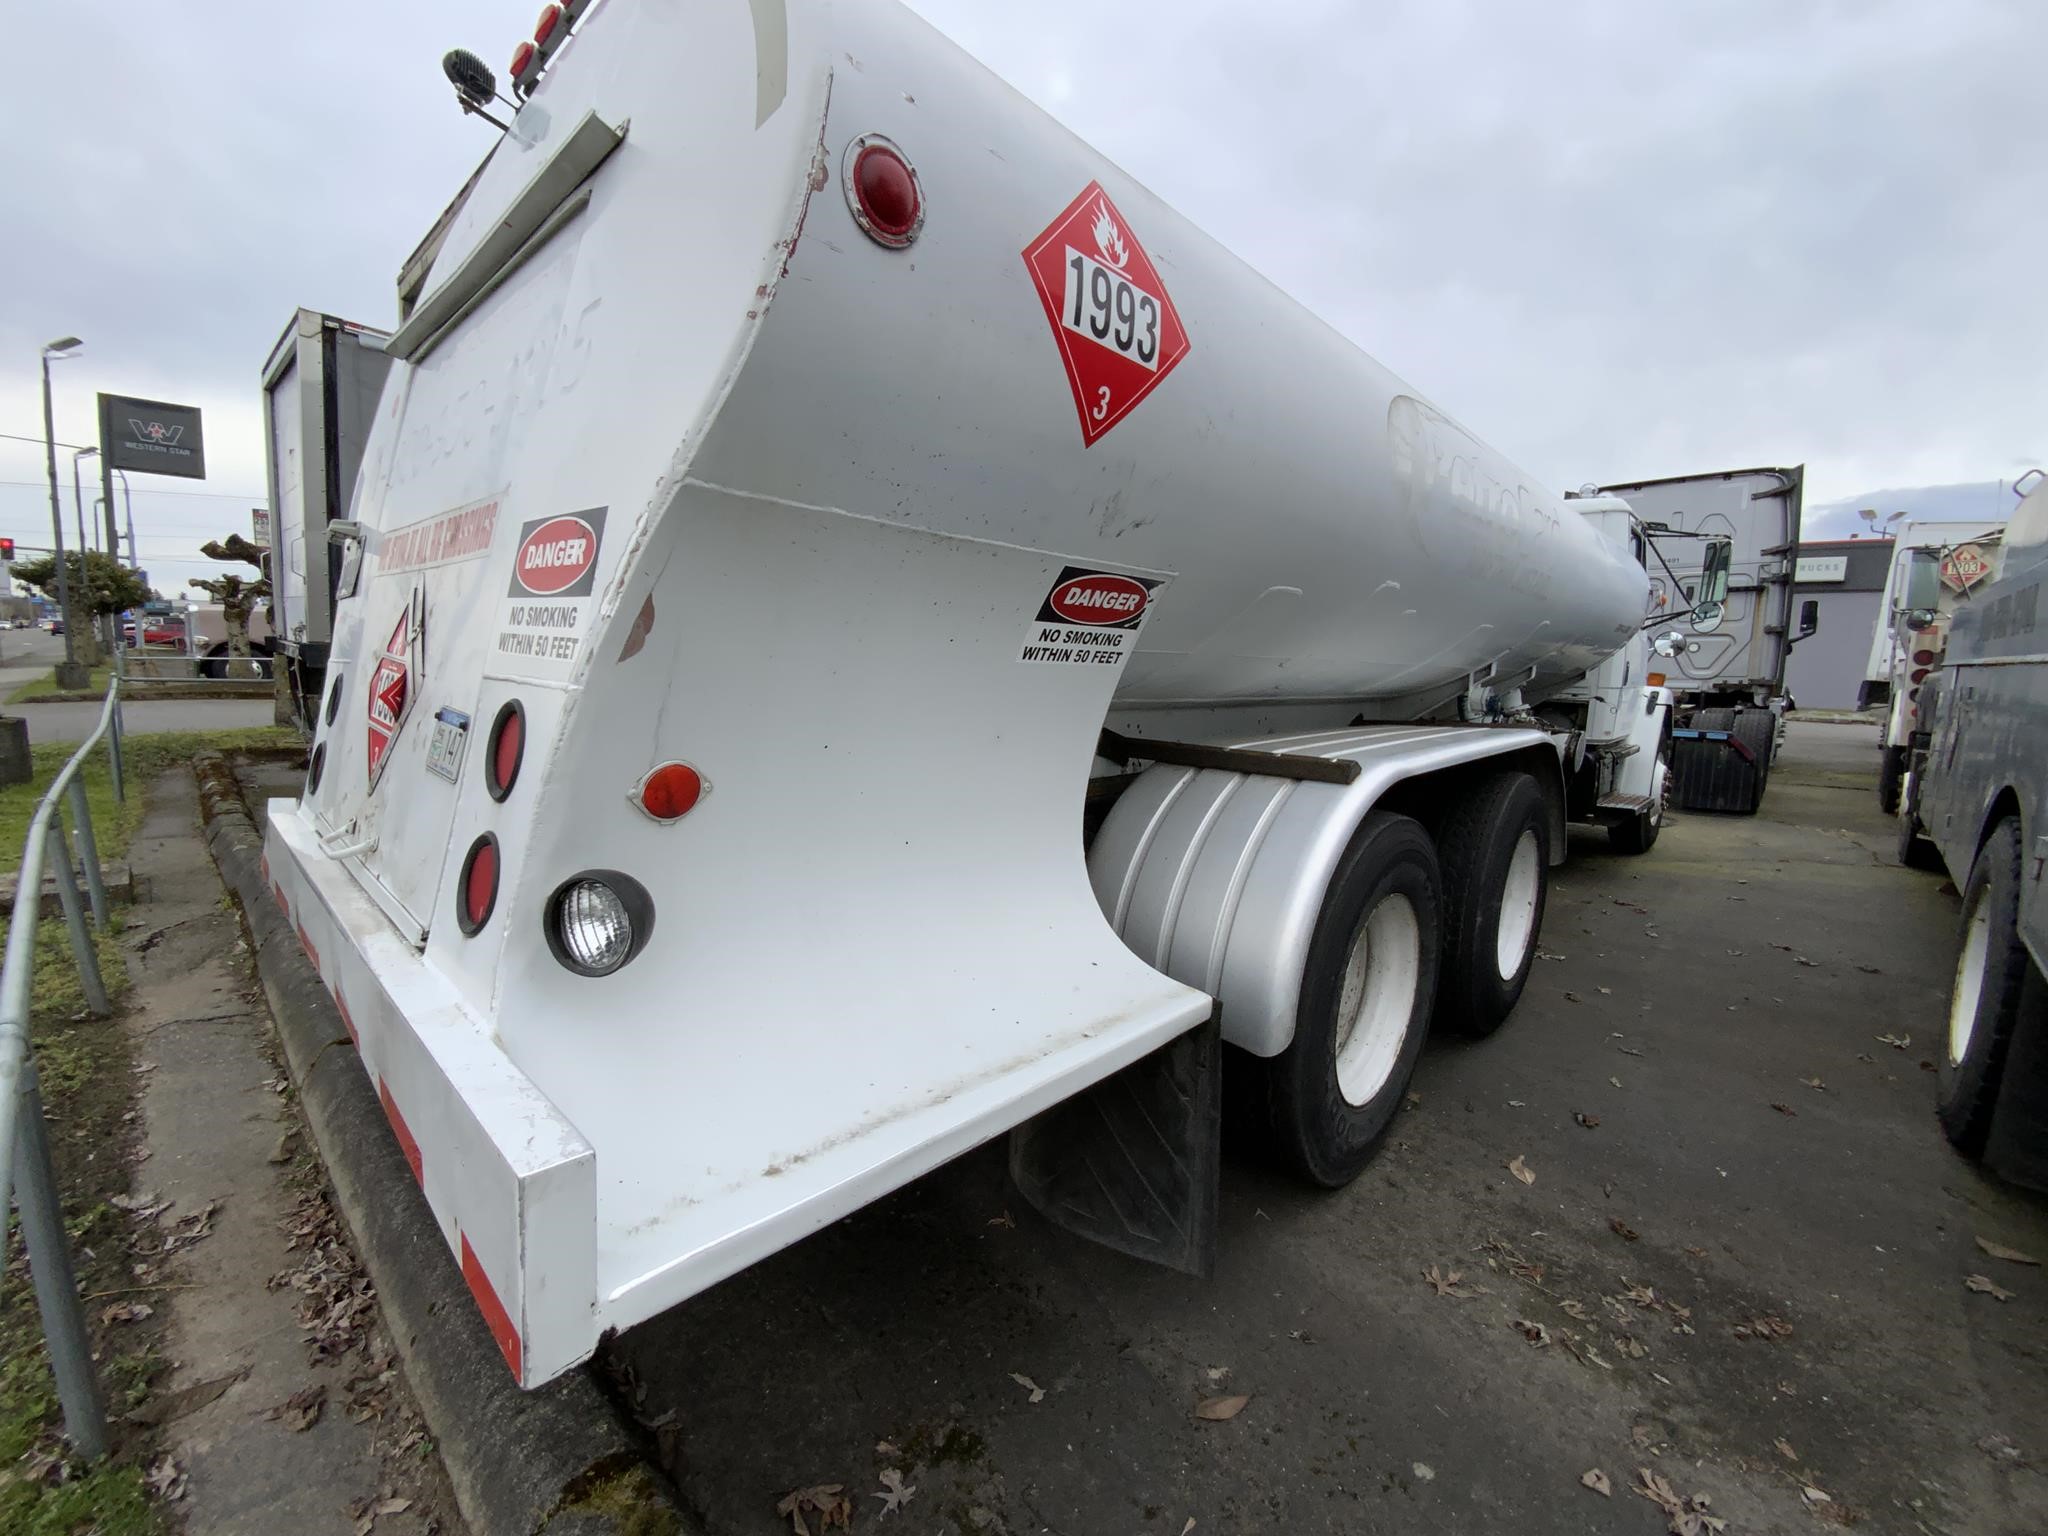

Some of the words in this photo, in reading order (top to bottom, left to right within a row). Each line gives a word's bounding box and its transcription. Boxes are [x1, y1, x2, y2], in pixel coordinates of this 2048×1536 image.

[1068, 255, 1157, 363] 1993
[1092, 386, 1111, 420] 3
[125, 442, 167, 453] WESTERN
[169, 448, 191, 456] STAR
[524, 537, 587, 569] DANGER
[1063, 586, 1141, 611] DANGER
[509, 606, 525, 626] NO
[526, 606, 578, 628] SMOKING
[498, 632, 534, 656] WITHIN
[535, 635, 549, 657] 50
[550, 636, 579, 660] FEET
[1038, 628, 1061, 643] NO
[1062, 631, 1124, 647] SMOKING
[1022, 646, 1073, 662] WITHIN
[1073, 650, 1090, 663] 50
[1091, 651, 1124, 664] FEET
